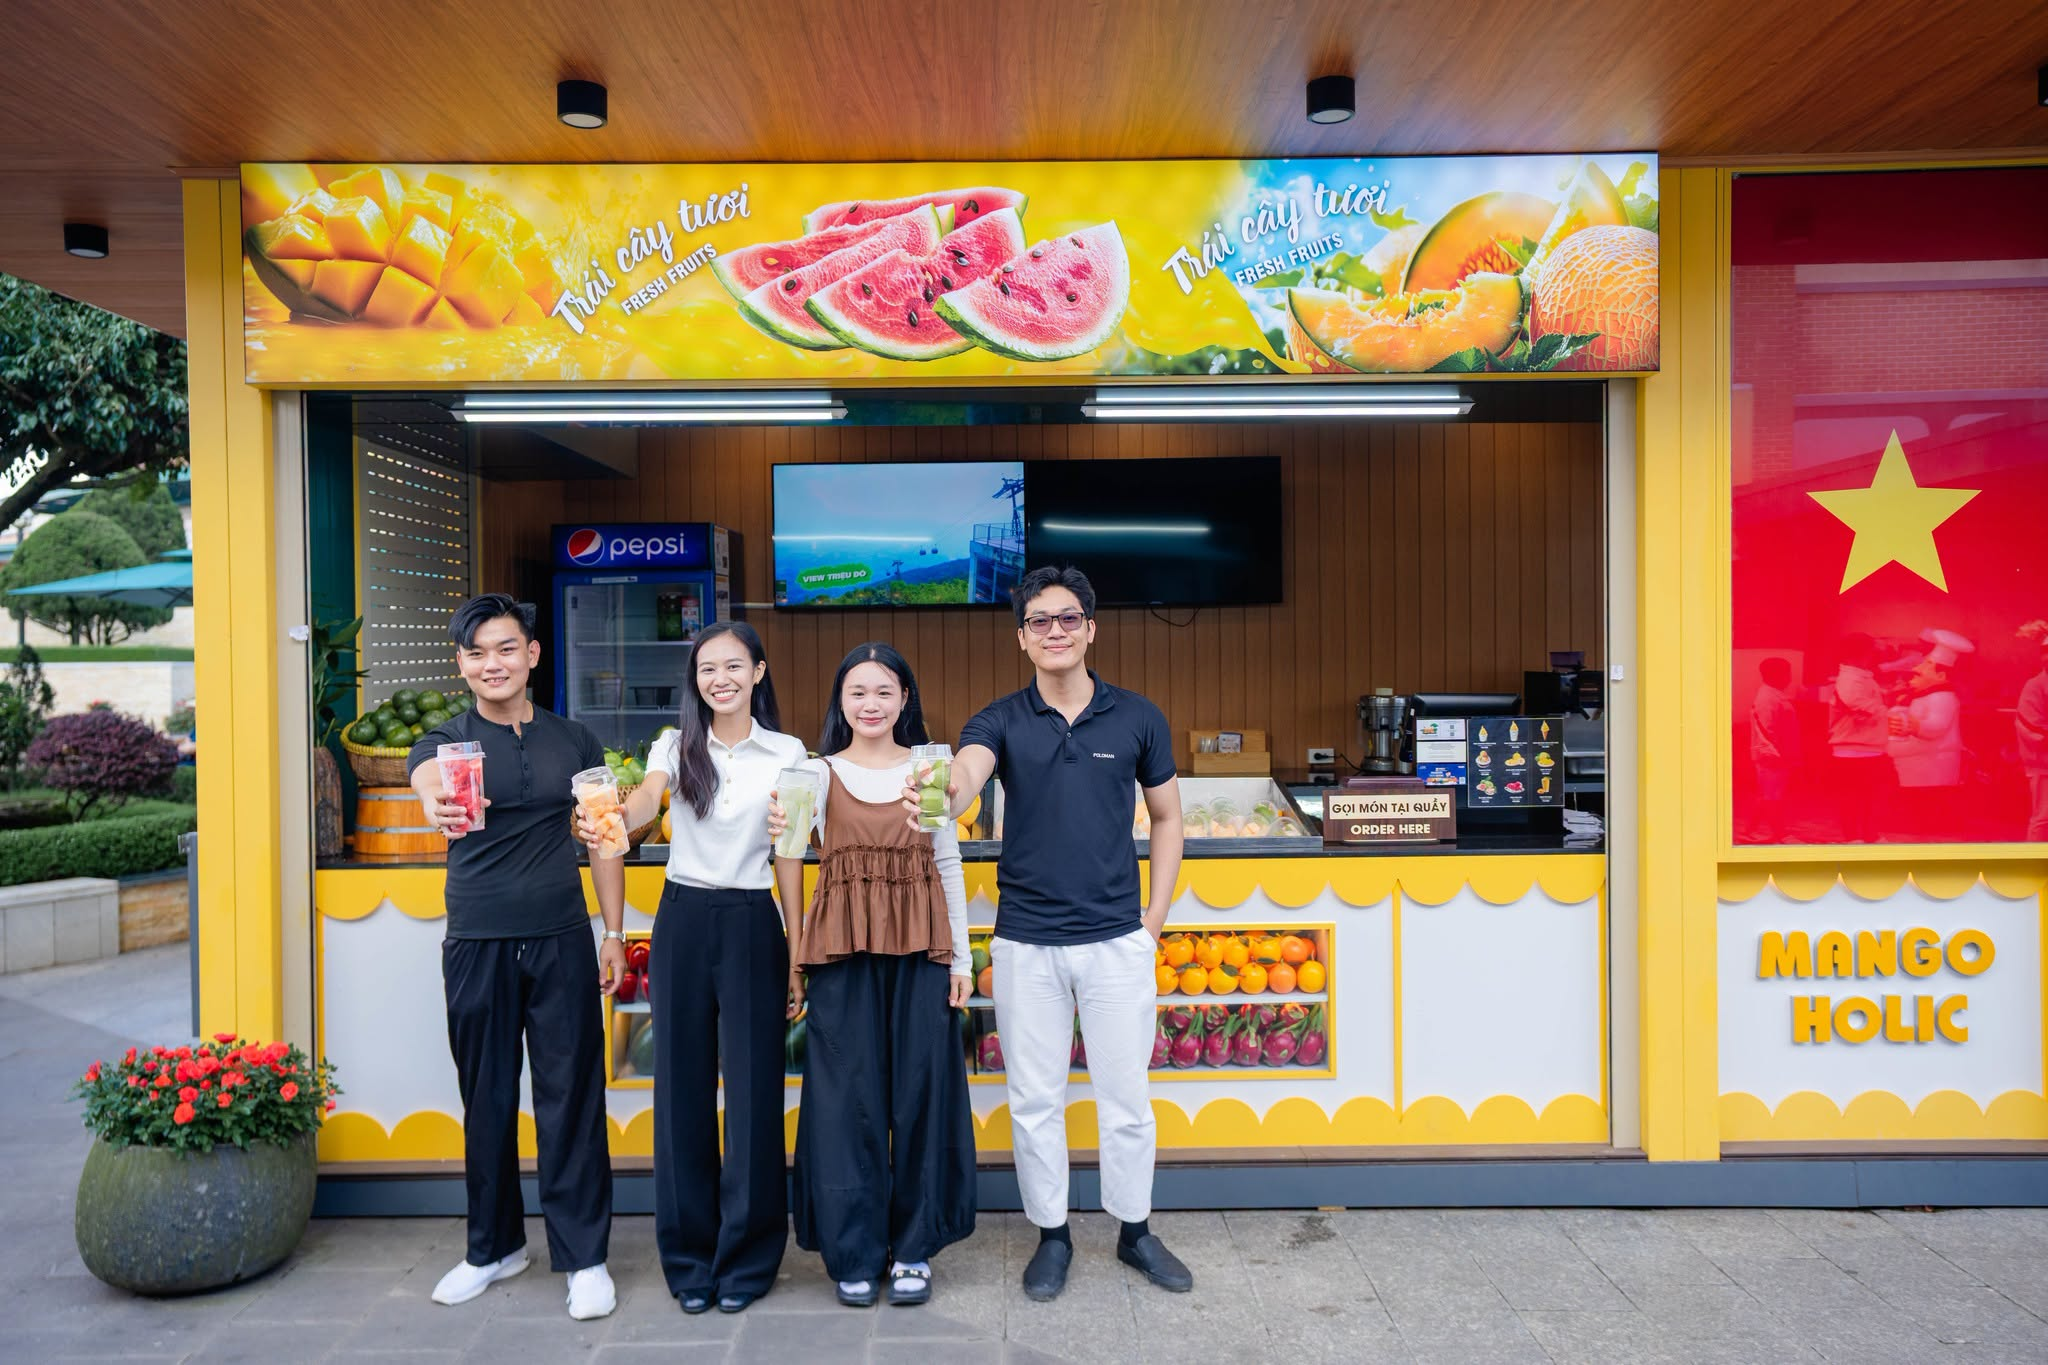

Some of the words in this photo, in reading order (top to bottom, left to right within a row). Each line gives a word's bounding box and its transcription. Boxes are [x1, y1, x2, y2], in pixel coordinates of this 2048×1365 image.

[551, 260, 616, 335] Trái
[616, 220, 674, 273] cây
[677, 183, 751, 233] tươi
[1162, 222, 1235, 296] Trái
[1241, 199, 1304, 244] cây
[1312, 179, 1391, 219] tươi
[1234, 256, 1287, 288] FRESH
[1287, 232, 1344, 267] FRUITS
[620, 276, 669, 316] FRESH
[665, 243, 718, 285] FRUITS
[610, 533, 685, 561] pepsi
[802, 574, 825, 583] VIEW
[1332, 803, 1355, 816] GỌI
[1359, 800, 1388, 813] MÓN
[1391, 803, 1410, 815] TẠI
[1350, 823, 1396, 835] ORDER
[1398, 823, 1431, 834] HERE
[1757, 927, 1996, 978] MANGO
[1790, 994, 1969, 1043] HOLIC
